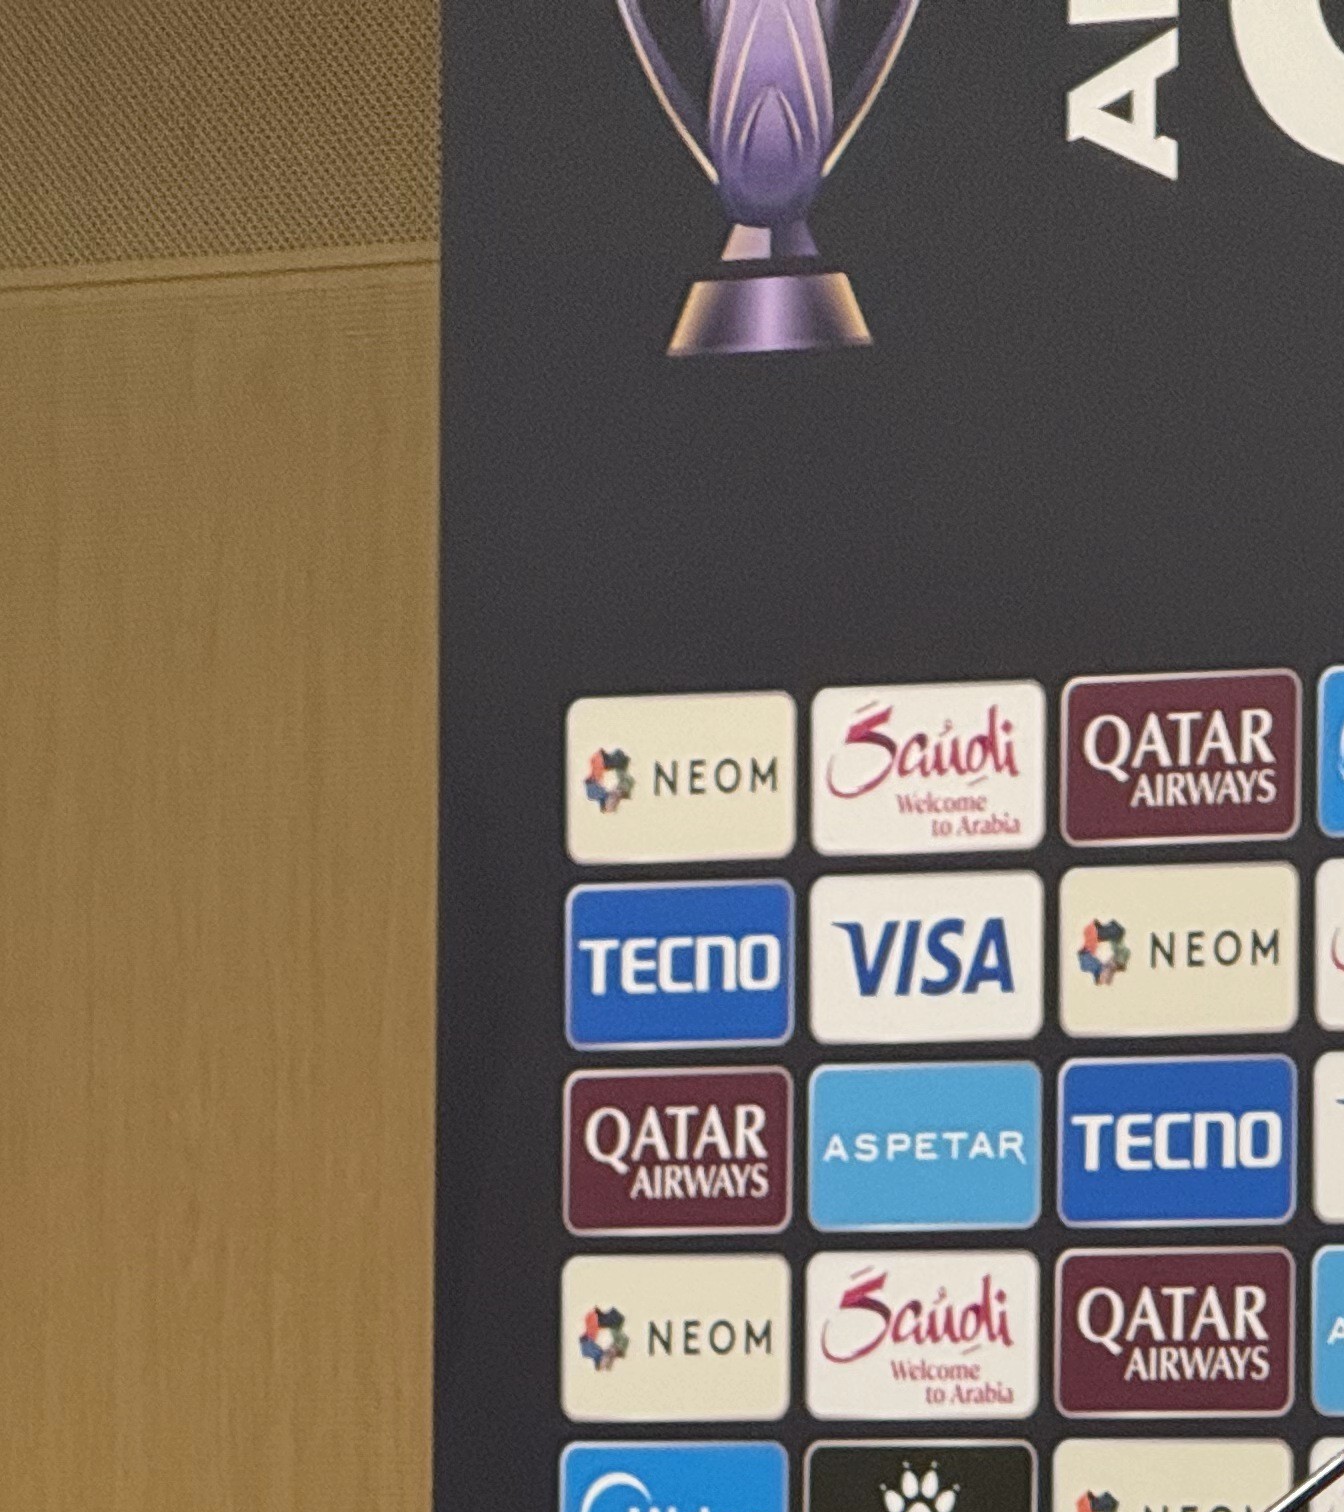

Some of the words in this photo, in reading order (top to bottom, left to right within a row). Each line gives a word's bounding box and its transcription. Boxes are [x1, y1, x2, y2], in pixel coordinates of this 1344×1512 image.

[826, 700, 1020, 799] Saudi
[1083, 708, 1276, 783] QATAR
[653, 756, 779, 796] NEOM
[1129, 769, 1278, 808] AIRWAYS
[896, 793, 986, 815] Welcome
[931, 817, 953, 836] to
[956, 815, 1022, 836] Arabia
[578, 934, 781, 996] TECNO
[831, 917, 1015, 997] VISA
[1149, 929, 1281, 968] NEOM
[585, 1104, 768, 1174] QATAR
[822, 1130, 1027, 1165] ASPETAR
[1070, 1111, 1282, 1172] TECNO
[629, 1163, 769, 1200] AIRWAYS
[820, 1266, 1014, 1364] Saudi
[1077, 1285, 1269, 1356] QATAR
[648, 1319, 772, 1356] NEOM
[890, 1359, 980, 1382] Welcome
[1123, 1346, 1270, 1382] AIRWAYS
[924, 1385, 947, 1405] to
[950, 1382, 1014, 1405] Arabia
